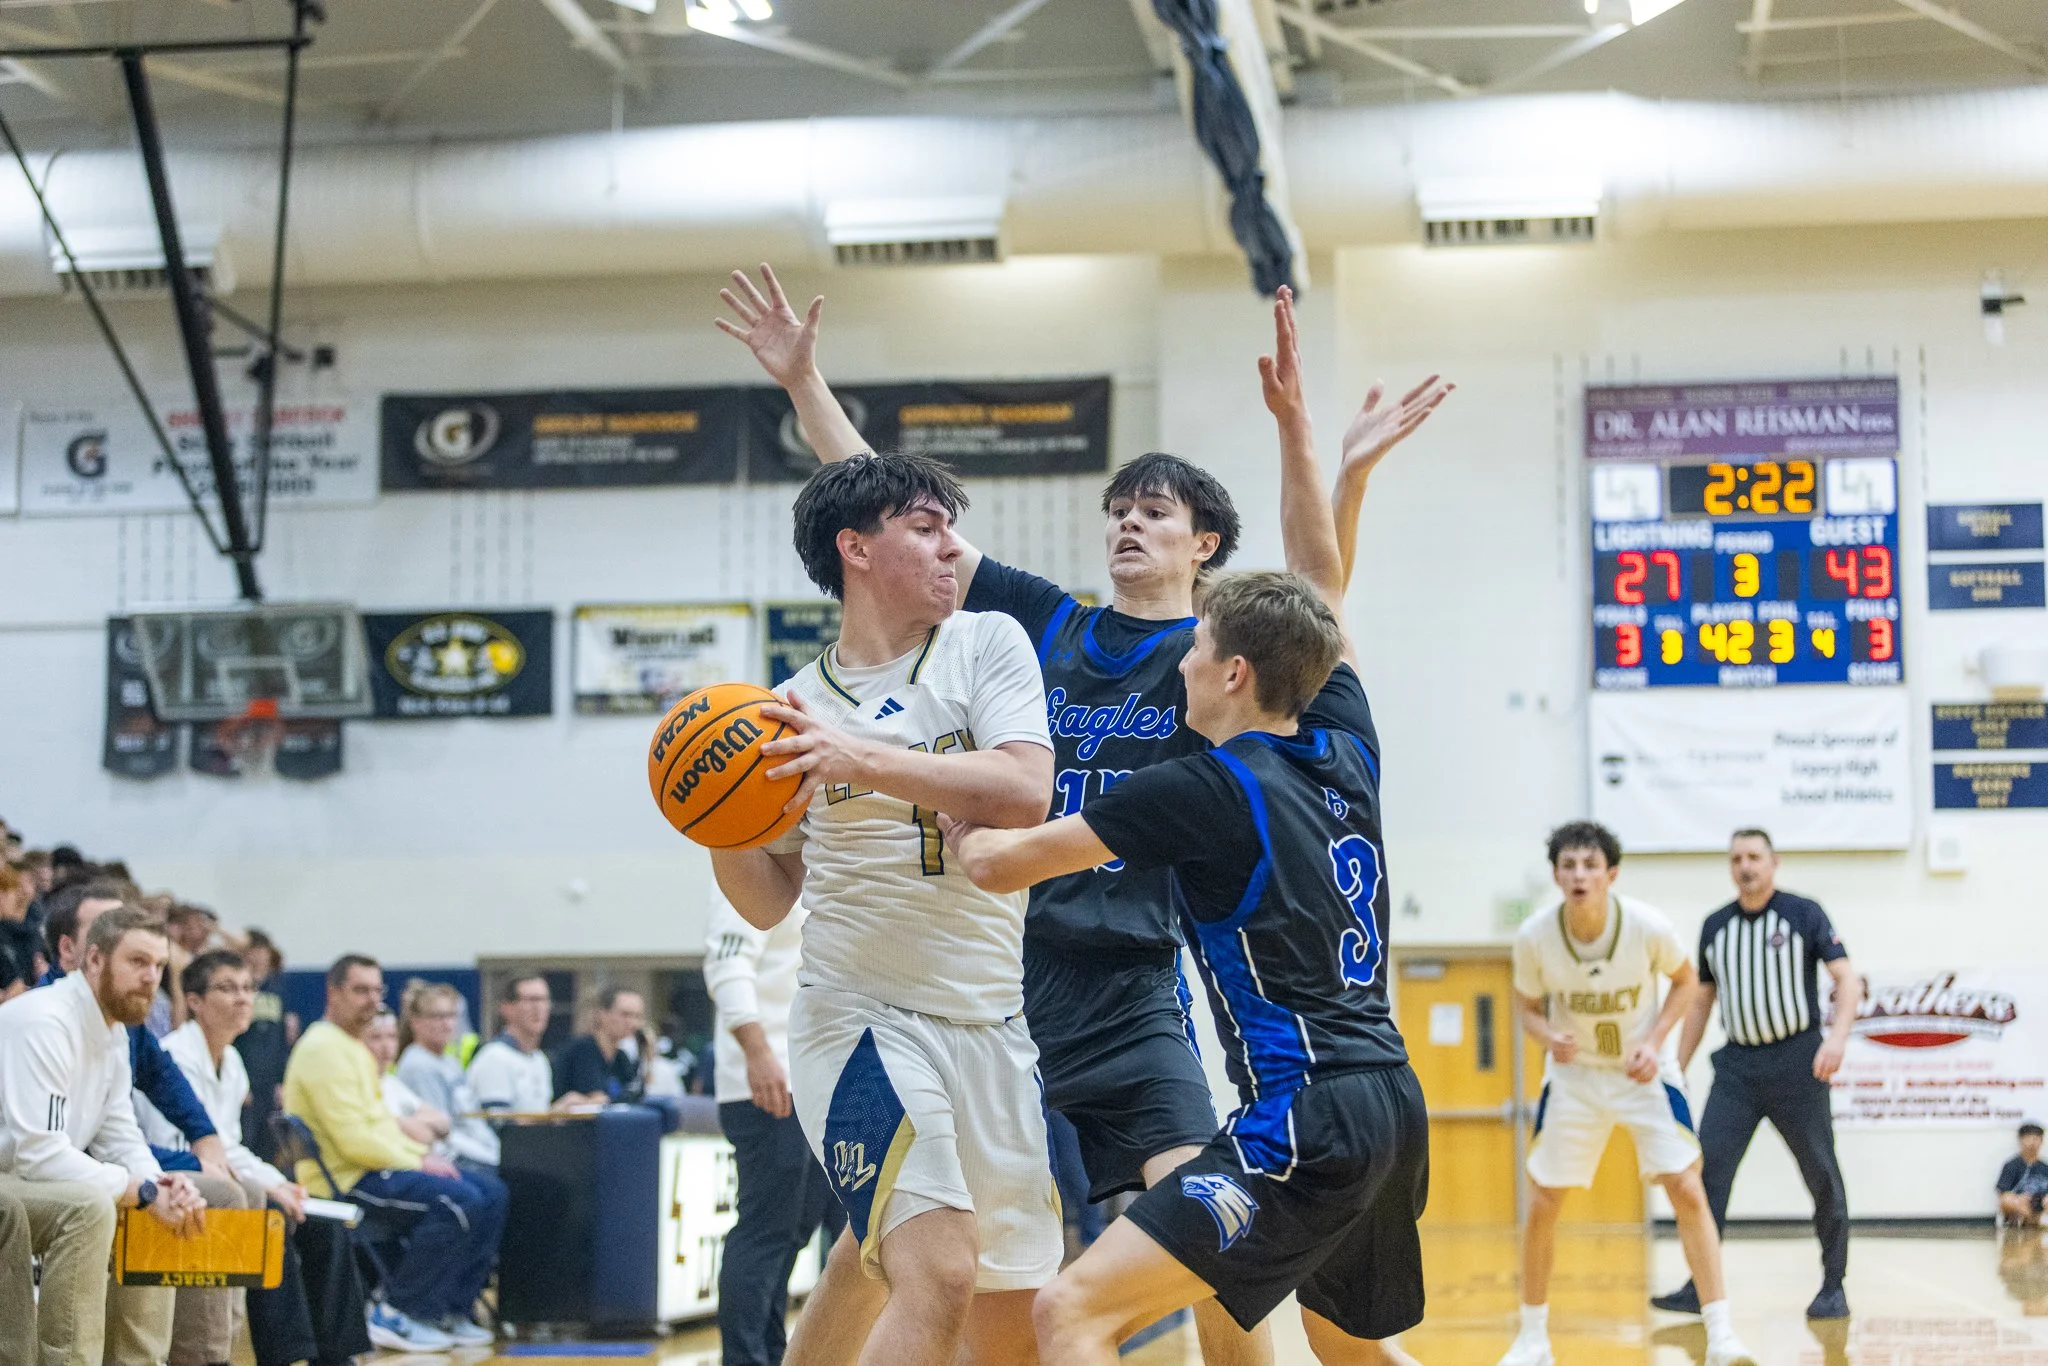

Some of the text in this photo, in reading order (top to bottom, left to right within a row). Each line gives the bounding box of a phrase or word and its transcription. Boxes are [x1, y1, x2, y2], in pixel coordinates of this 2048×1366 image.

[1649, 406, 1727, 438] ALAN
[1735, 403, 1860, 436] REISMAN
[1704, 460, 1815, 515] 2:22
[1595, 516, 1887, 550] LIGHTNING GUEST
[1614, 551, 1680, 605] 27
[1734, 552, 1760, 598] 3
[1826, 545, 1892, 598] 43
[1616, 622, 1643, 667] 3
[1661, 629, 1683, 665] 3
[1699, 619, 1755, 665] 42
[1768, 618, 1795, 664] 3
[1811, 628, 1836, 658] 4
[1868, 616, 1893, 660] 3
[653, 696, 710, 763] NCAA
[1047, 687, 1178, 761] Eagles
[670, 717, 763, 804] Wilson
[912, 804, 945, 876] 1
[1328, 834, 1383, 990] 3
[1560, 984, 1641, 1014] LEGACY
[1594, 1021, 1620, 1057] 0
[161, 1272, 228, 1287] LEGACY
